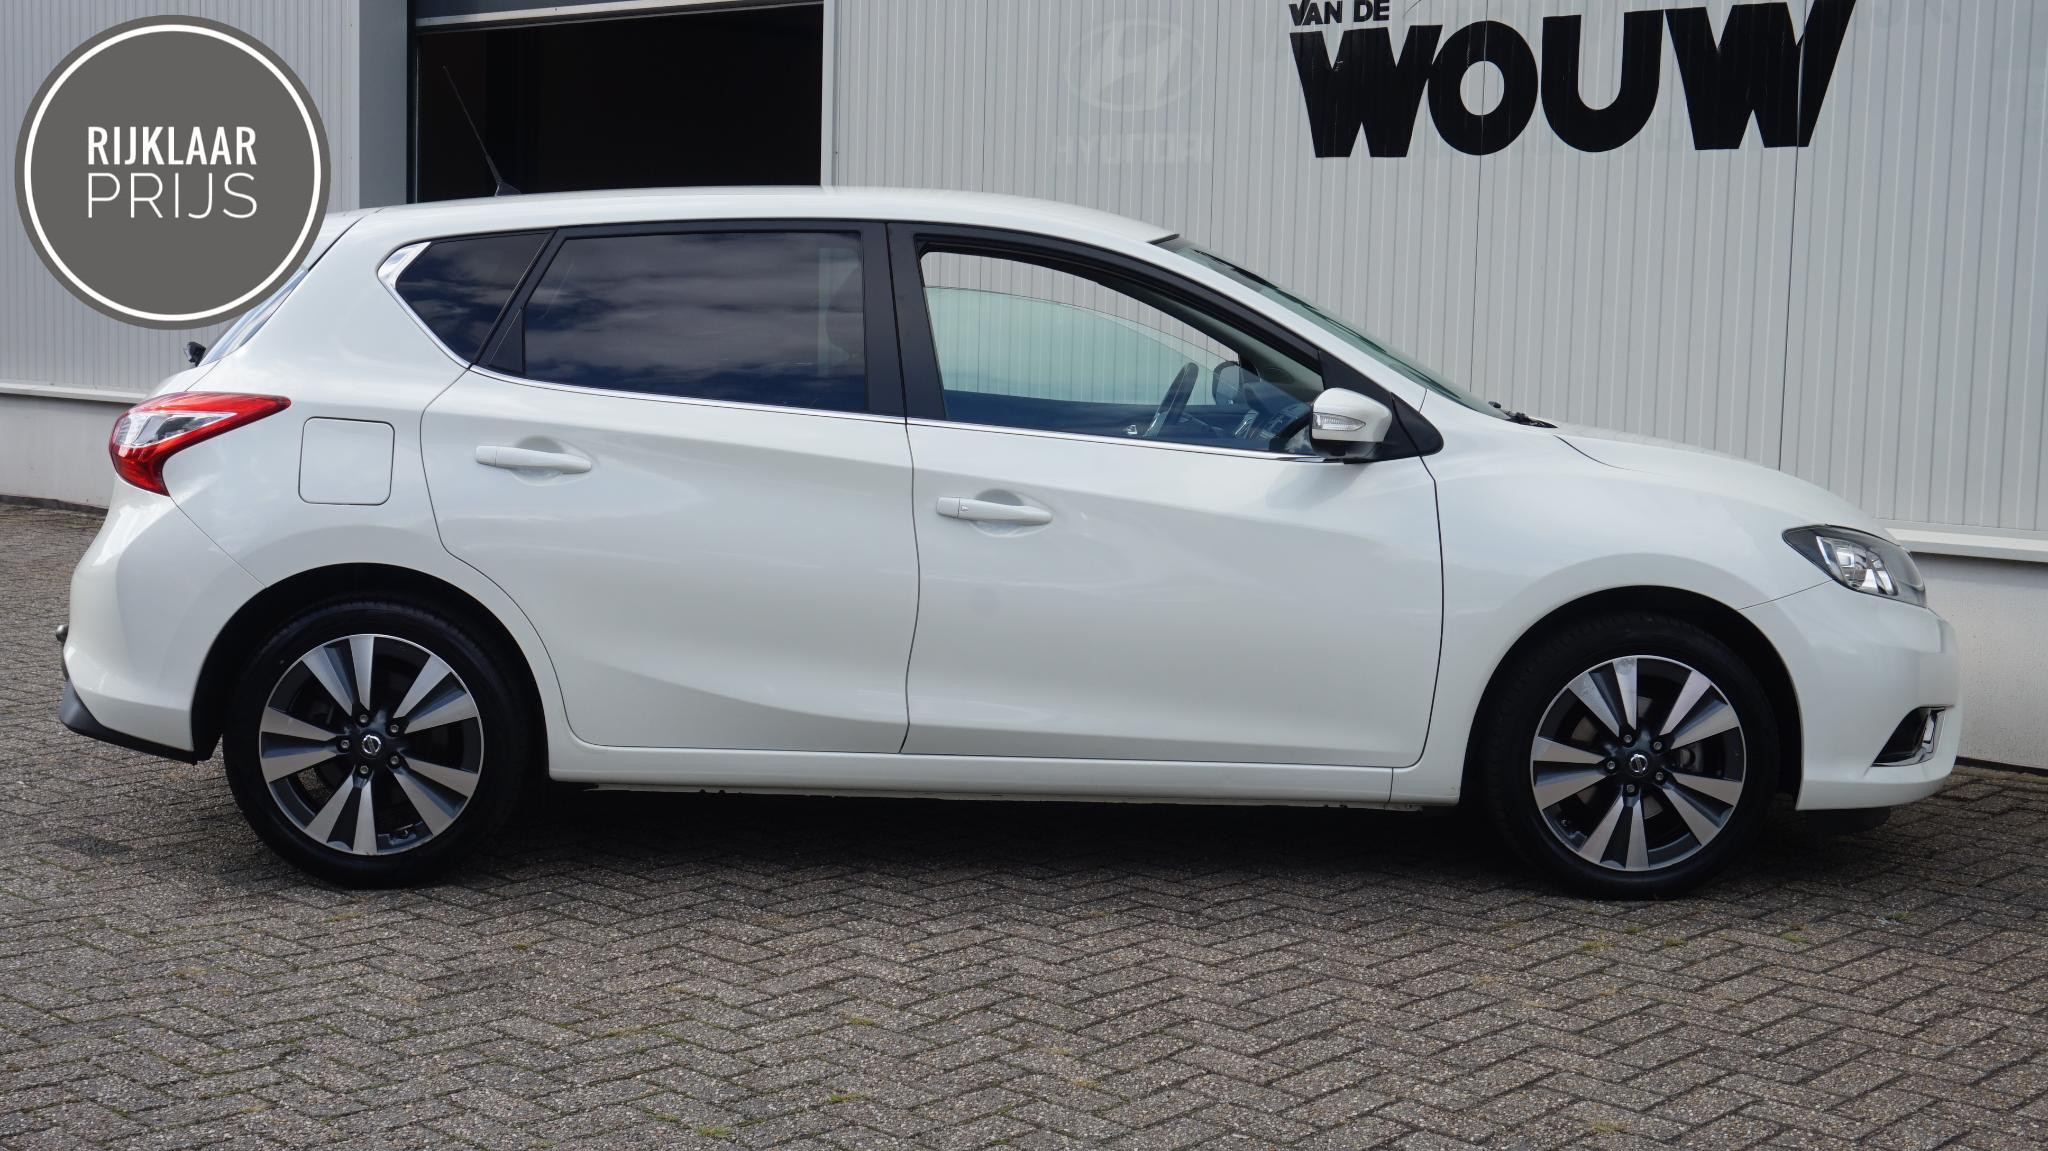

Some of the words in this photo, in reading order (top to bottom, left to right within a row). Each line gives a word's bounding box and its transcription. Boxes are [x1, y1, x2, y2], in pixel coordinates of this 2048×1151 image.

[1288, 0, 1343, 26] VAN
[1353, 0, 1390, 23] DE
[1289, 0, 1856, 157] WOUW
